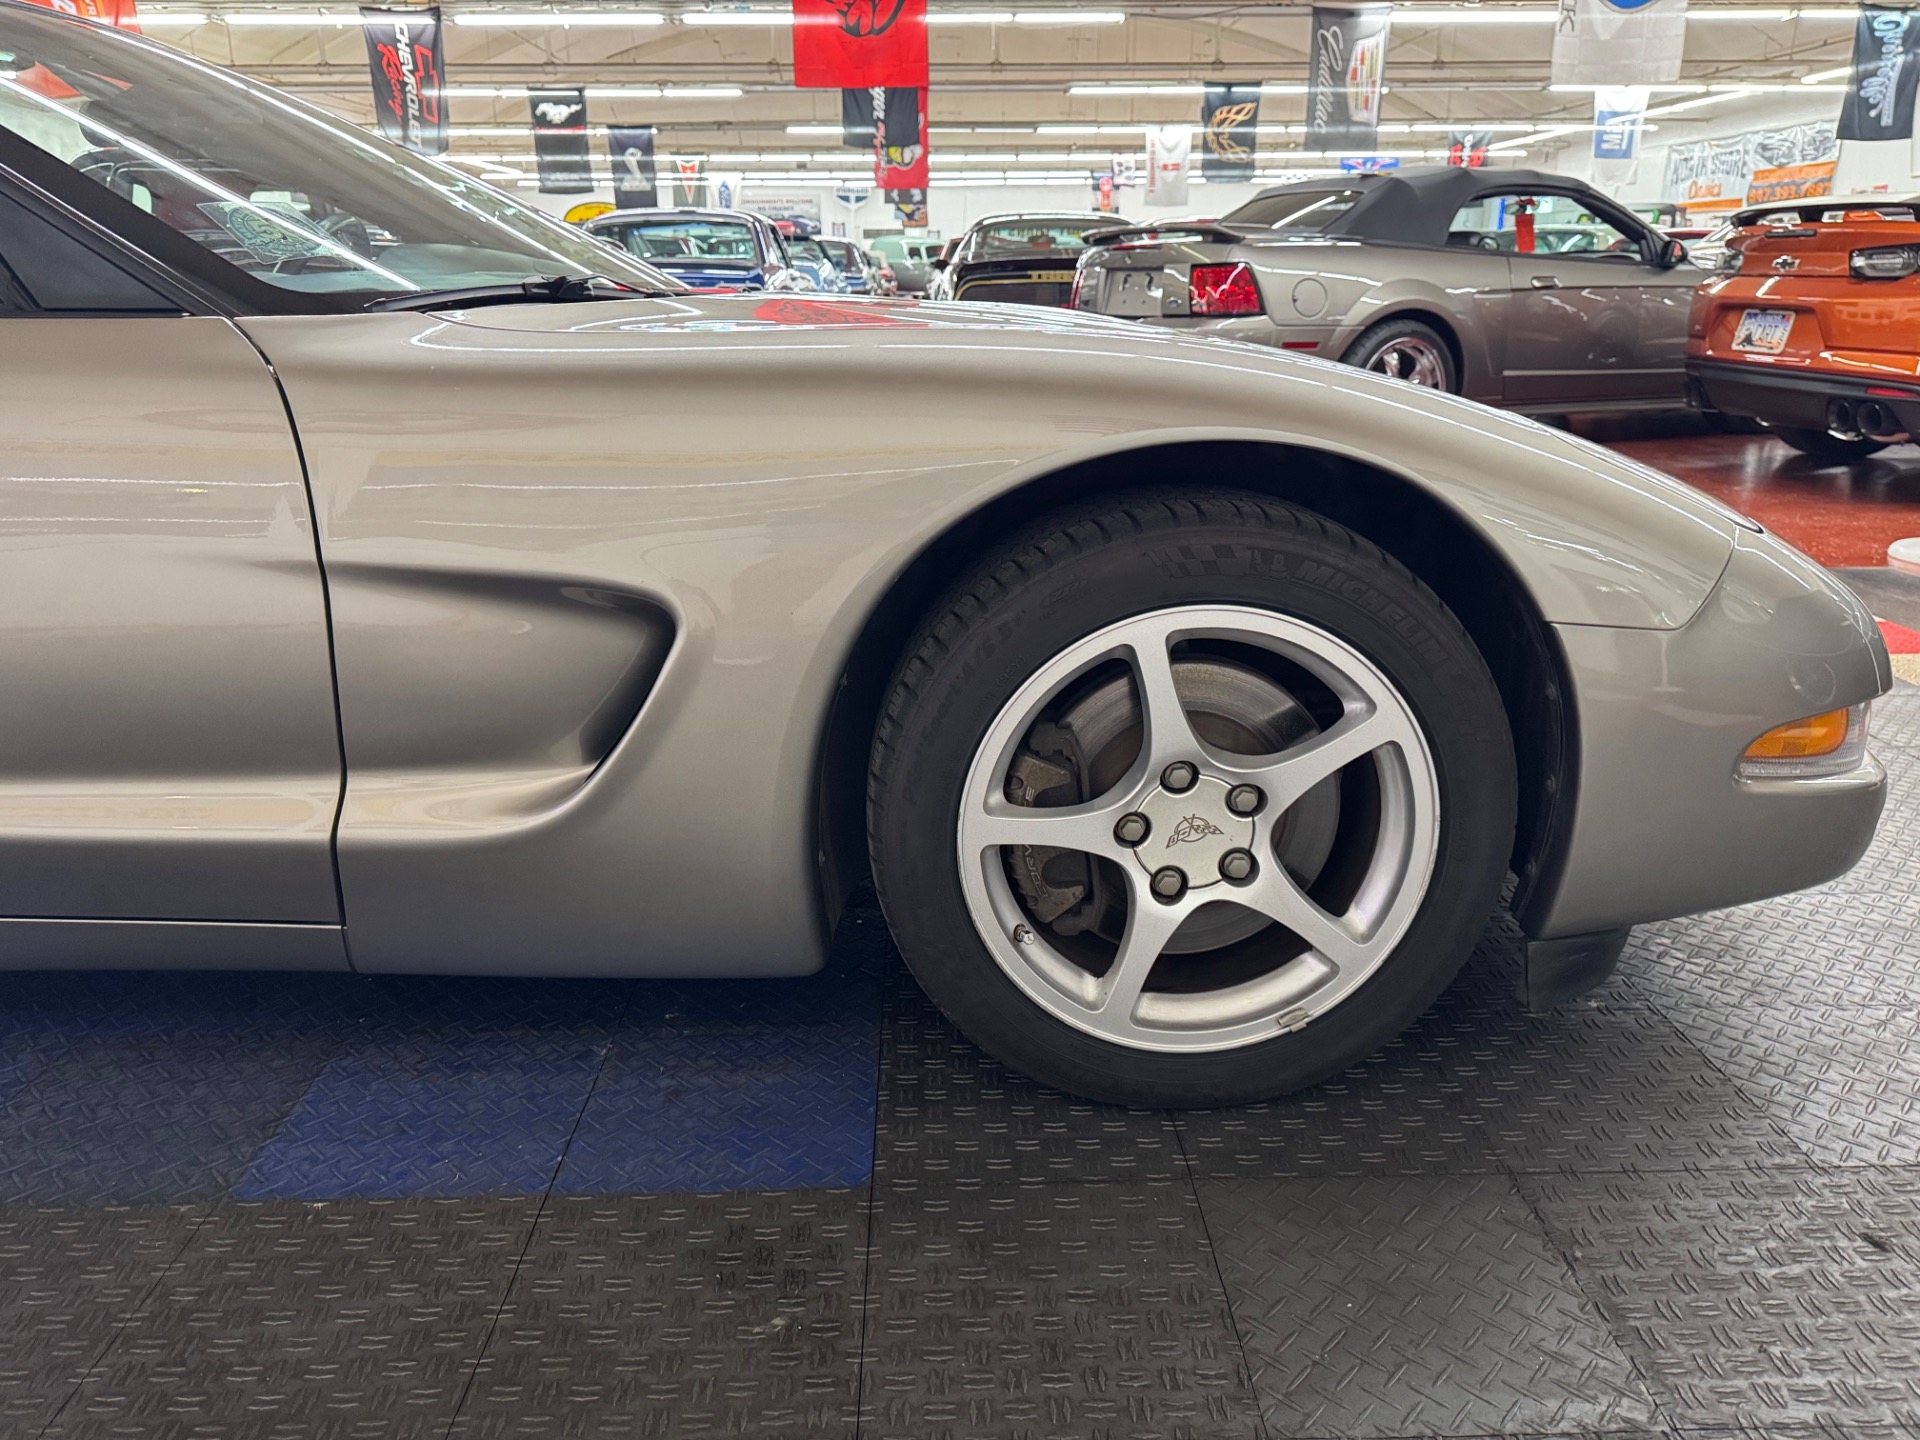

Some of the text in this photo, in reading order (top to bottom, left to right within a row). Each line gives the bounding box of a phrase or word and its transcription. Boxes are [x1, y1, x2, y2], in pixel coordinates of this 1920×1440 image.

[377, 43, 404, 121] Racing
[394, 23, 422, 149] CHEVROLET
[1314, 26, 1343, 134] Cadillac
[1296, 560, 1450, 666] MICHELIN
